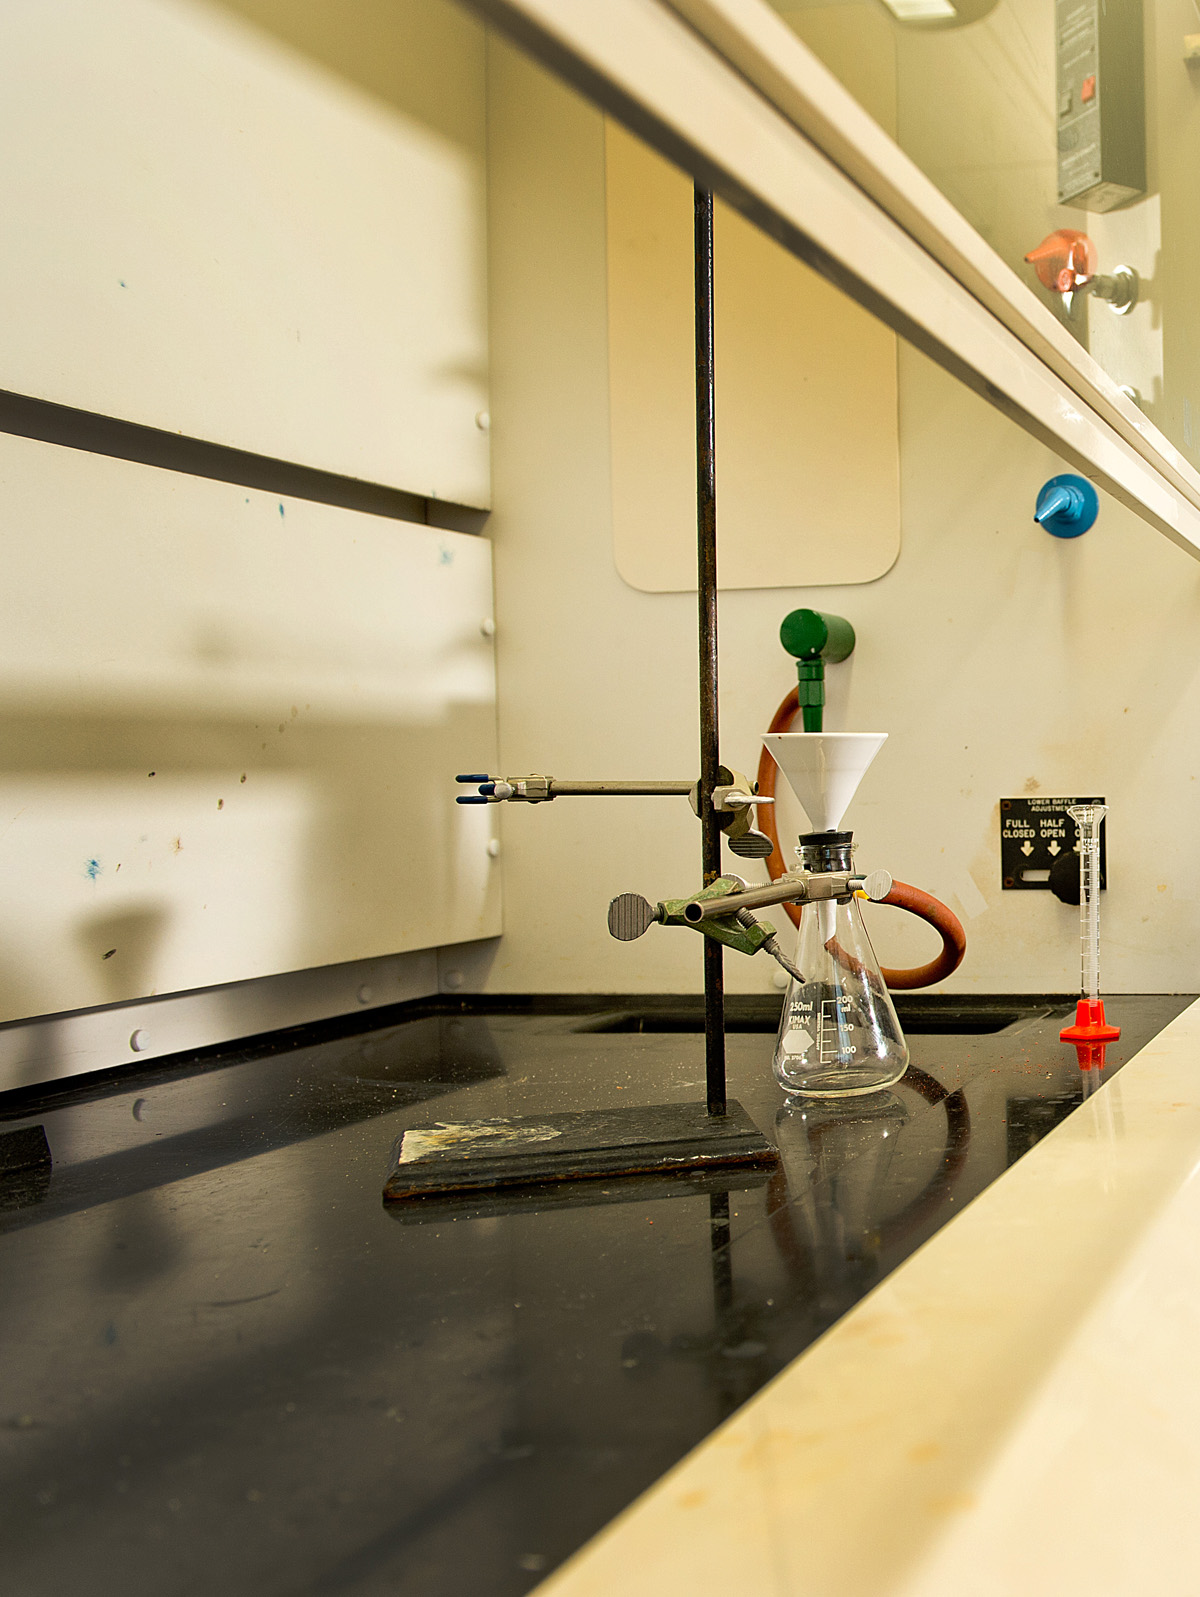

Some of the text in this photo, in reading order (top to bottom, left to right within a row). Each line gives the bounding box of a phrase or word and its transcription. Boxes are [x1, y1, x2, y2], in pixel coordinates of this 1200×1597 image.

[1005, 819, 1030, 828] FULL
[1040, 818, 1065, 828] HALF
[1002, 829, 1036, 838] CLOSED
[1040, 829, 1066, 838] OPEN
[837, 995, 854, 1004] 200
[789, 1001, 814, 1012] 250ml
[841, 1004, 851, 1013] ml
[788, 1015, 812, 1026] KIMAX
[839, 1023, 855, 1032] 150
[841, 1045, 857, 1055] 100
